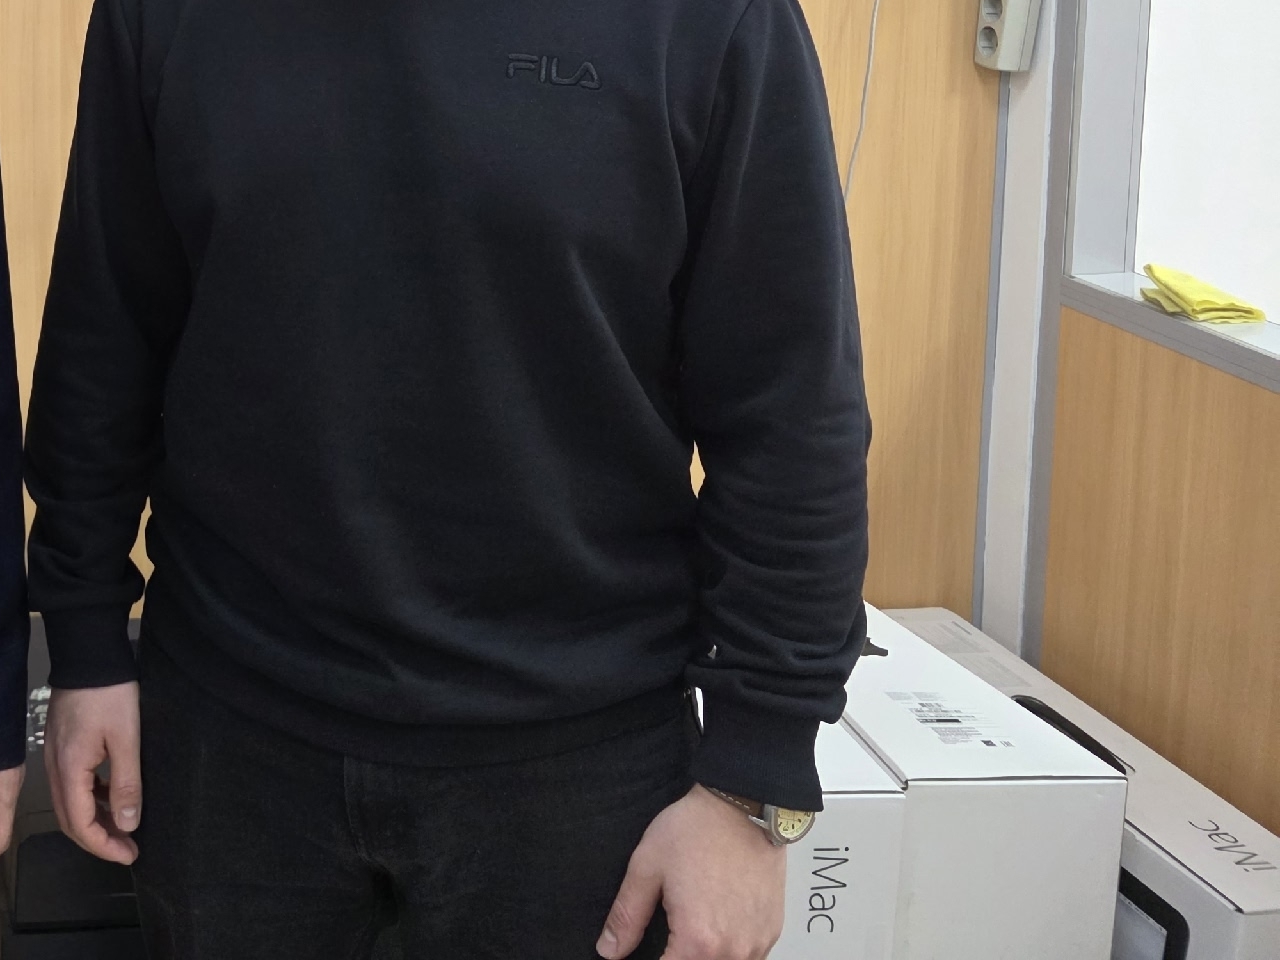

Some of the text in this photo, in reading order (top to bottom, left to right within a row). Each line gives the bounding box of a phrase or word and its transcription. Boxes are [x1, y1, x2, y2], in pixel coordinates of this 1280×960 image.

[507, 53, 601, 90] FILA
[1188, 820, 1278, 872] iMac
[807, 846, 850, 933] iMac
